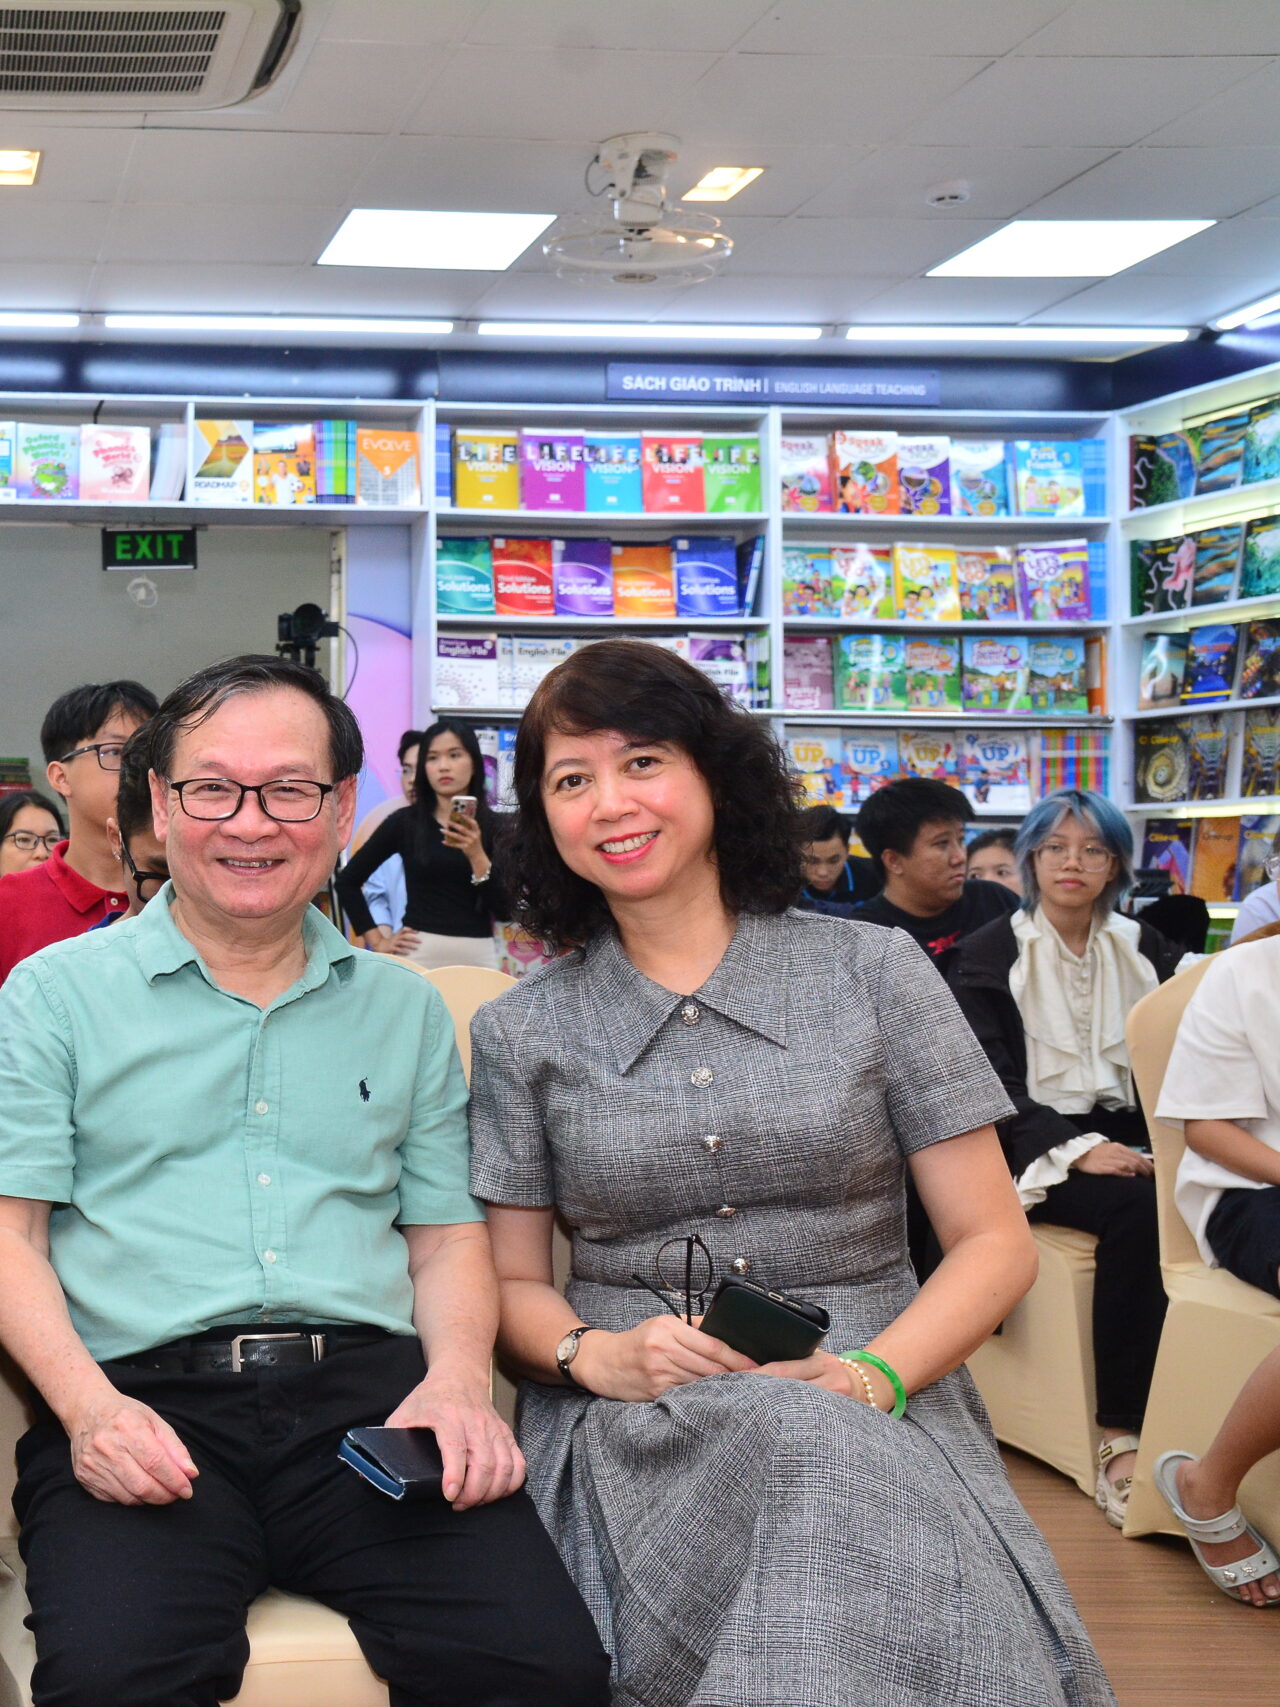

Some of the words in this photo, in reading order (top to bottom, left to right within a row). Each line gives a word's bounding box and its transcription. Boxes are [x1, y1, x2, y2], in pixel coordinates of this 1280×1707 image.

[775, 381, 818, 393] ENGLISH
[819, 382, 874, 395] LANGUAGE
[876, 383, 926, 396] TEACHING
[22, 443, 66, 455] Phonics
[362, 438, 411, 452] EVOLVE
[460, 445, 516, 461] LIFE
[526, 444, 583, 460] LIFE
[583, 447, 639, 463] LIFE
[645, 447, 702, 462] LIFE
[702, 447, 758, 463] LIFE
[466, 461, 509, 472] VISION
[533, 461, 576, 472] VISION
[589, 463, 634, 474] VISION
[651, 463, 695, 474] VISION
[708, 463, 751, 474] VISION
[194, 480, 238, 489] ROADMAP
[115, 534, 184, 560] EXIT
[1035, 566, 1057, 579] GO
[438, 581, 491, 593] Solutions
[498, 582, 551, 595] Solutions
[558, 584, 612, 596] Solutions
[616, 587, 672, 598] Solutions
[680, 584, 736, 596] Solutions
[439, 645, 471, 657] English
[471, 647, 489, 656] File
[517, 647, 548, 657] English
[548, 648, 566, 656] File
[793, 746, 824, 762] UP
[852, 749, 882, 765] UP
[915, 746, 940, 761] UP
[981, 747, 1010, 761] UP
